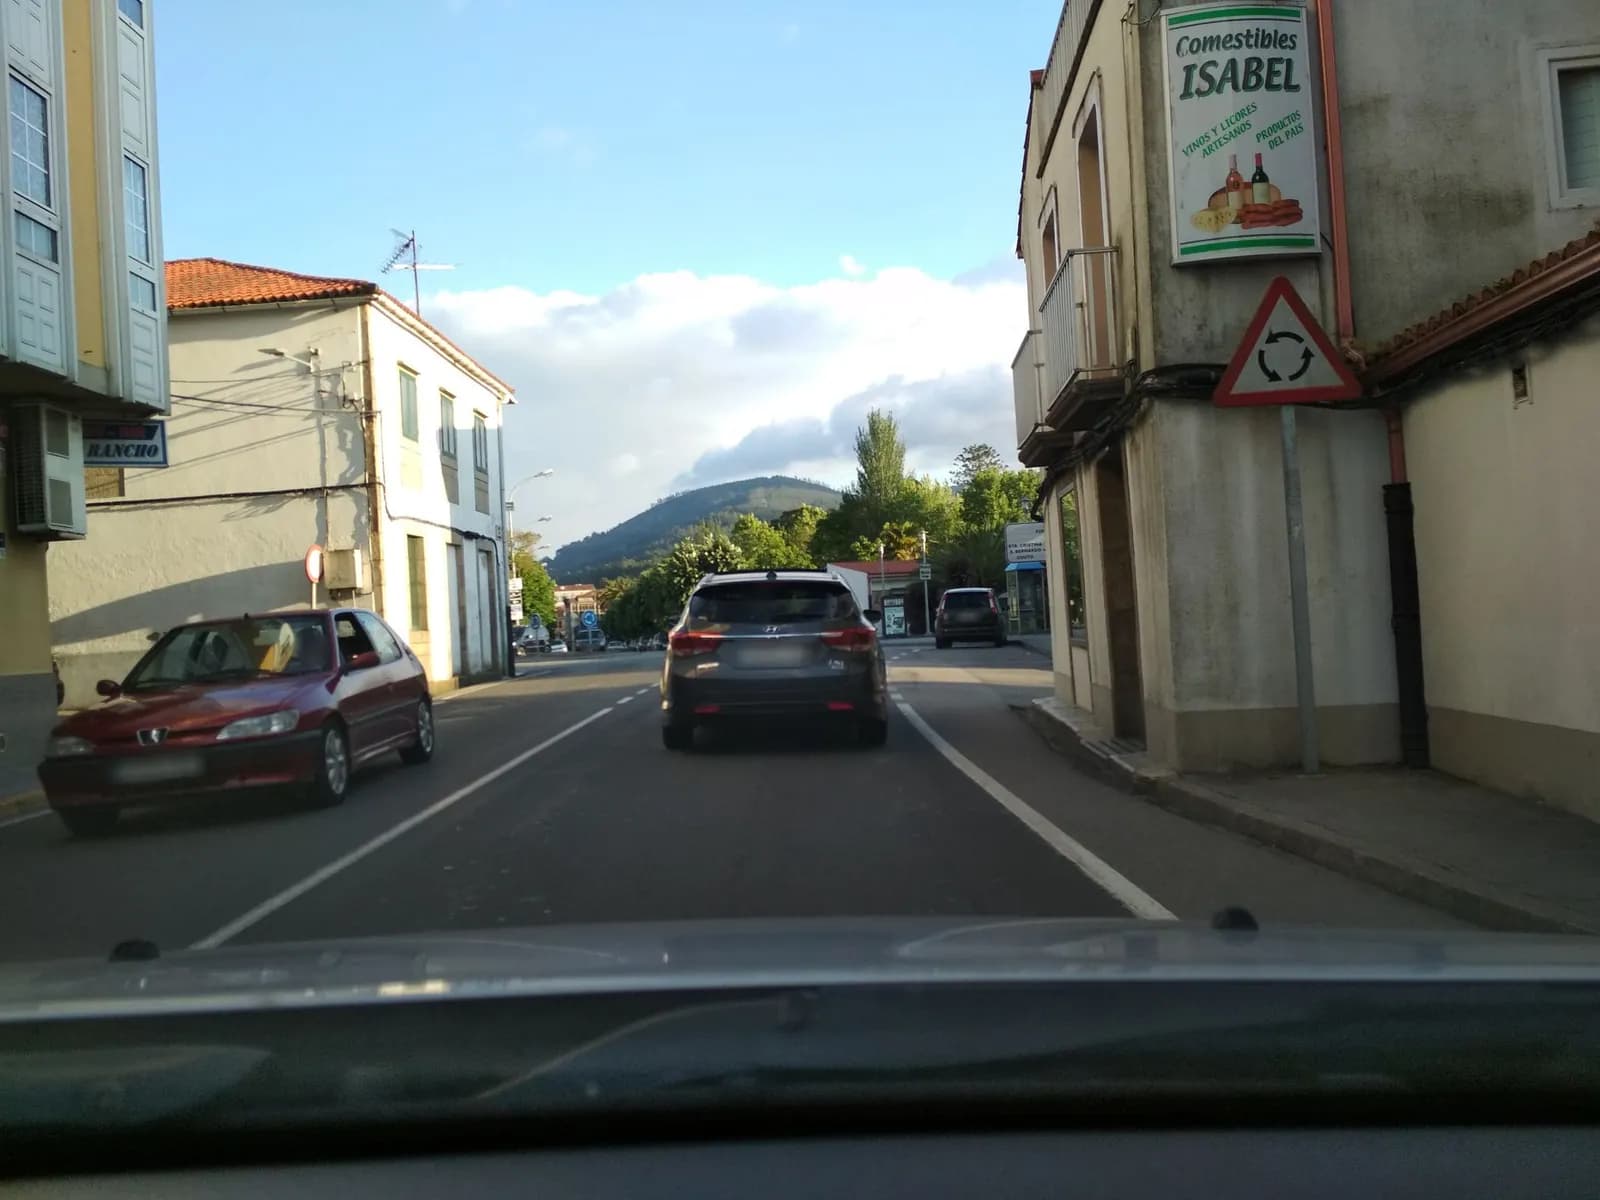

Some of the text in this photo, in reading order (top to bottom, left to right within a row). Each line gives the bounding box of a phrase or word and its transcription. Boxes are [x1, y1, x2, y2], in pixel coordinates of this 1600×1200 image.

[1176, 27, 1297, 57] Comestibles
[1179, 57, 1301, 101] ISABEL
[1182, 102, 1258, 157] VINOS Y LICORES
[1202, 119, 1253, 158] ARTESANOS
[1255, 109, 1302, 143] PRODUCTOS
[1267, 136, 1284, 151] DEL
[88, 443, 159, 458] RANCHO
